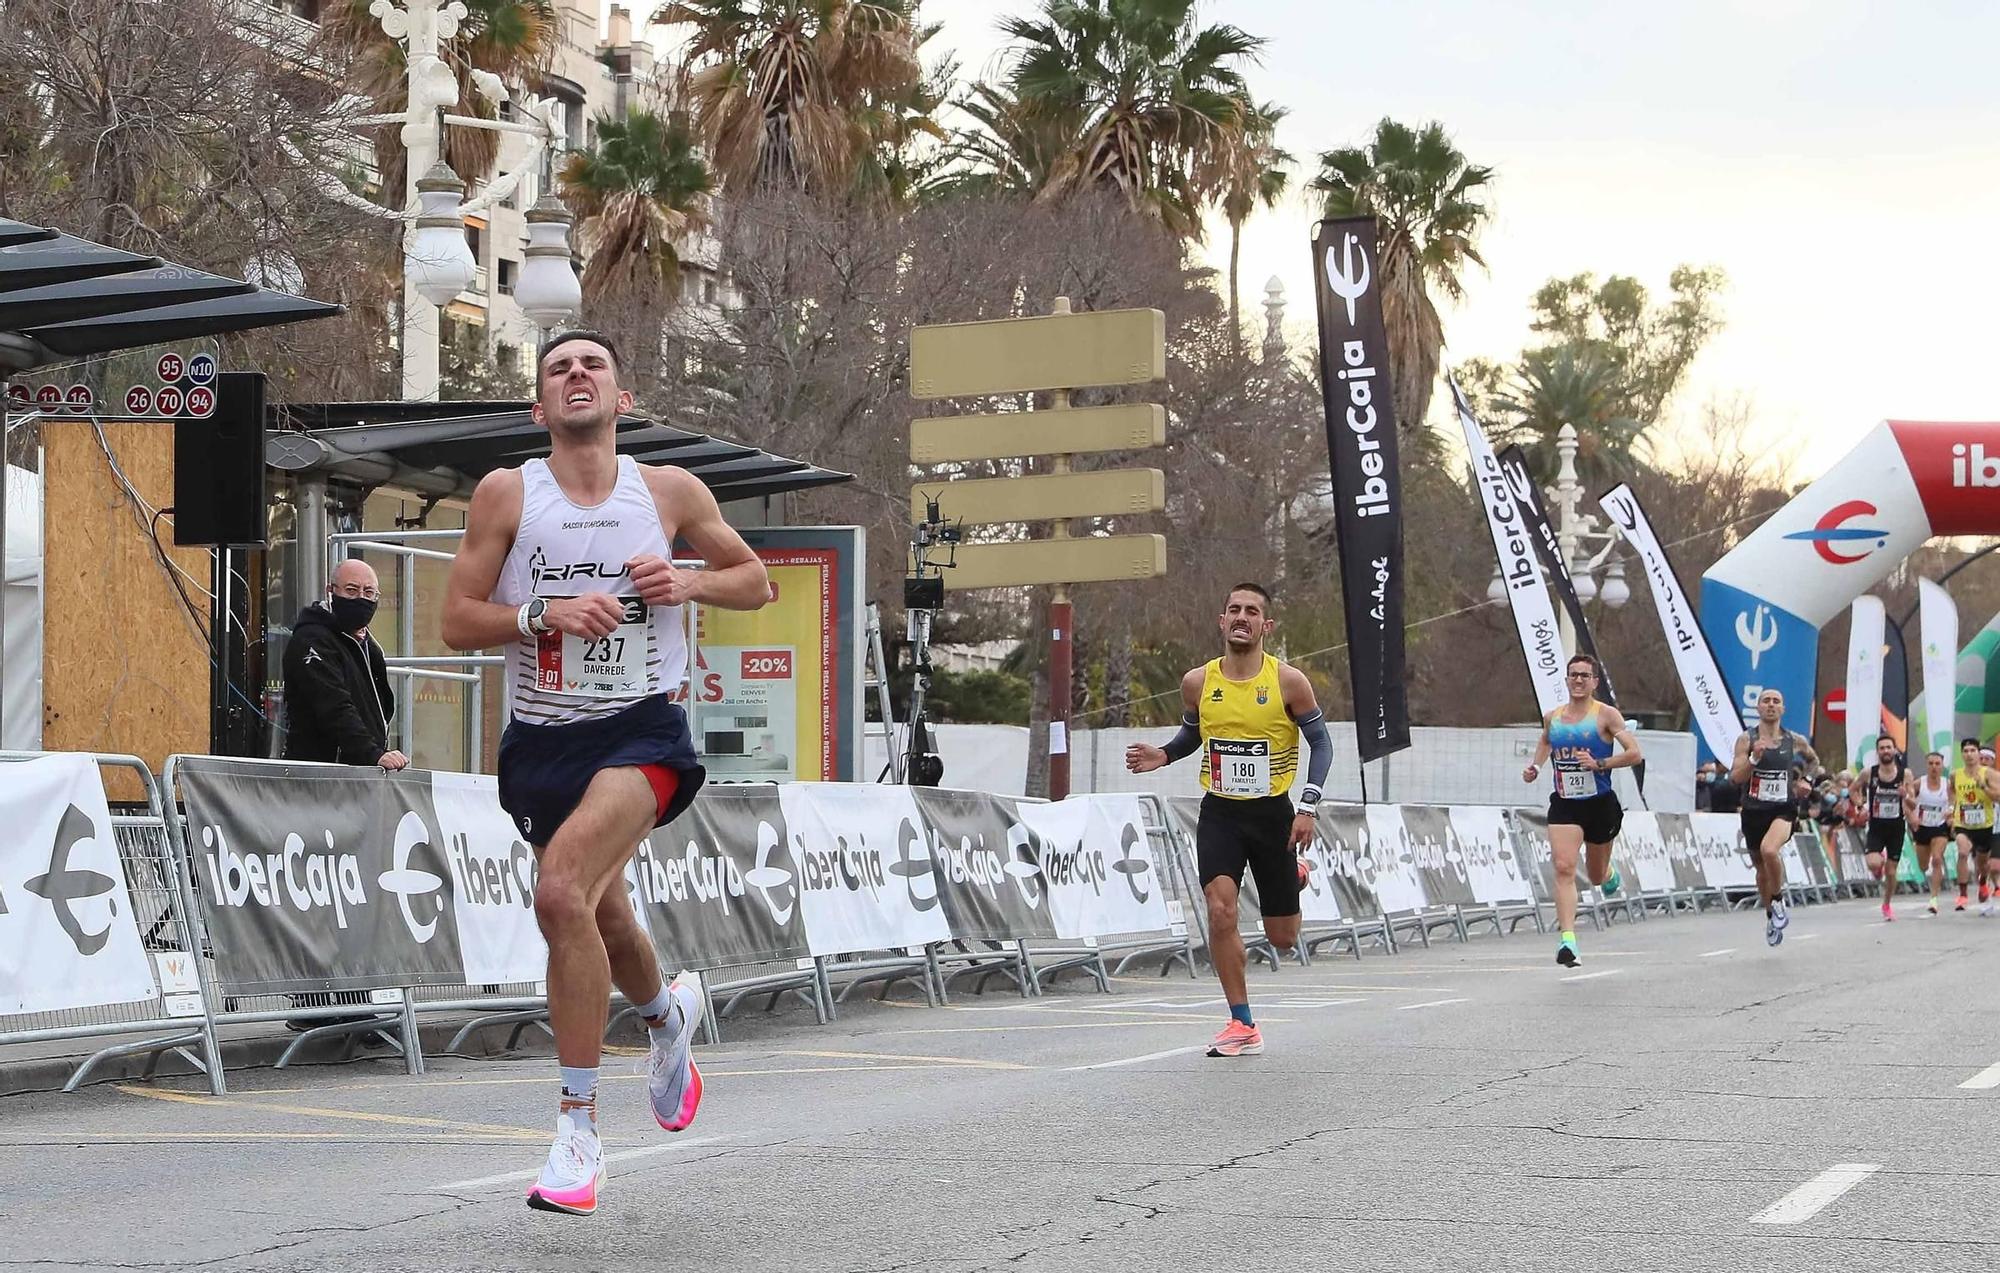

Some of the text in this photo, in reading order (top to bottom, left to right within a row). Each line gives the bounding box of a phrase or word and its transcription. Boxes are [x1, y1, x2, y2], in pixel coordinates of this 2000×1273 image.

[161, 360, 180, 376] 95
[190, 362, 213, 376] N10
[129, 393, 148, 408] 26
[160, 394, 178, 409] 70
[190, 394, 209, 409] 94
[1338, 340, 1390, 519] iberCaja
[791, 556, 822, 565] REBAJAS
[583, 637, 626, 663] 237
[584, 664, 626, 676] DAVEREDE
[744, 657, 788, 673] -20%
[545, 669, 559, 683] 01
[1213, 742, 1245, 754] iberCaja
[1232, 761, 1256, 778] 180
[202, 824, 368, 930] iberCaja
[453, 832, 538, 909] iberC
[638, 838, 745, 917] iberCaja
